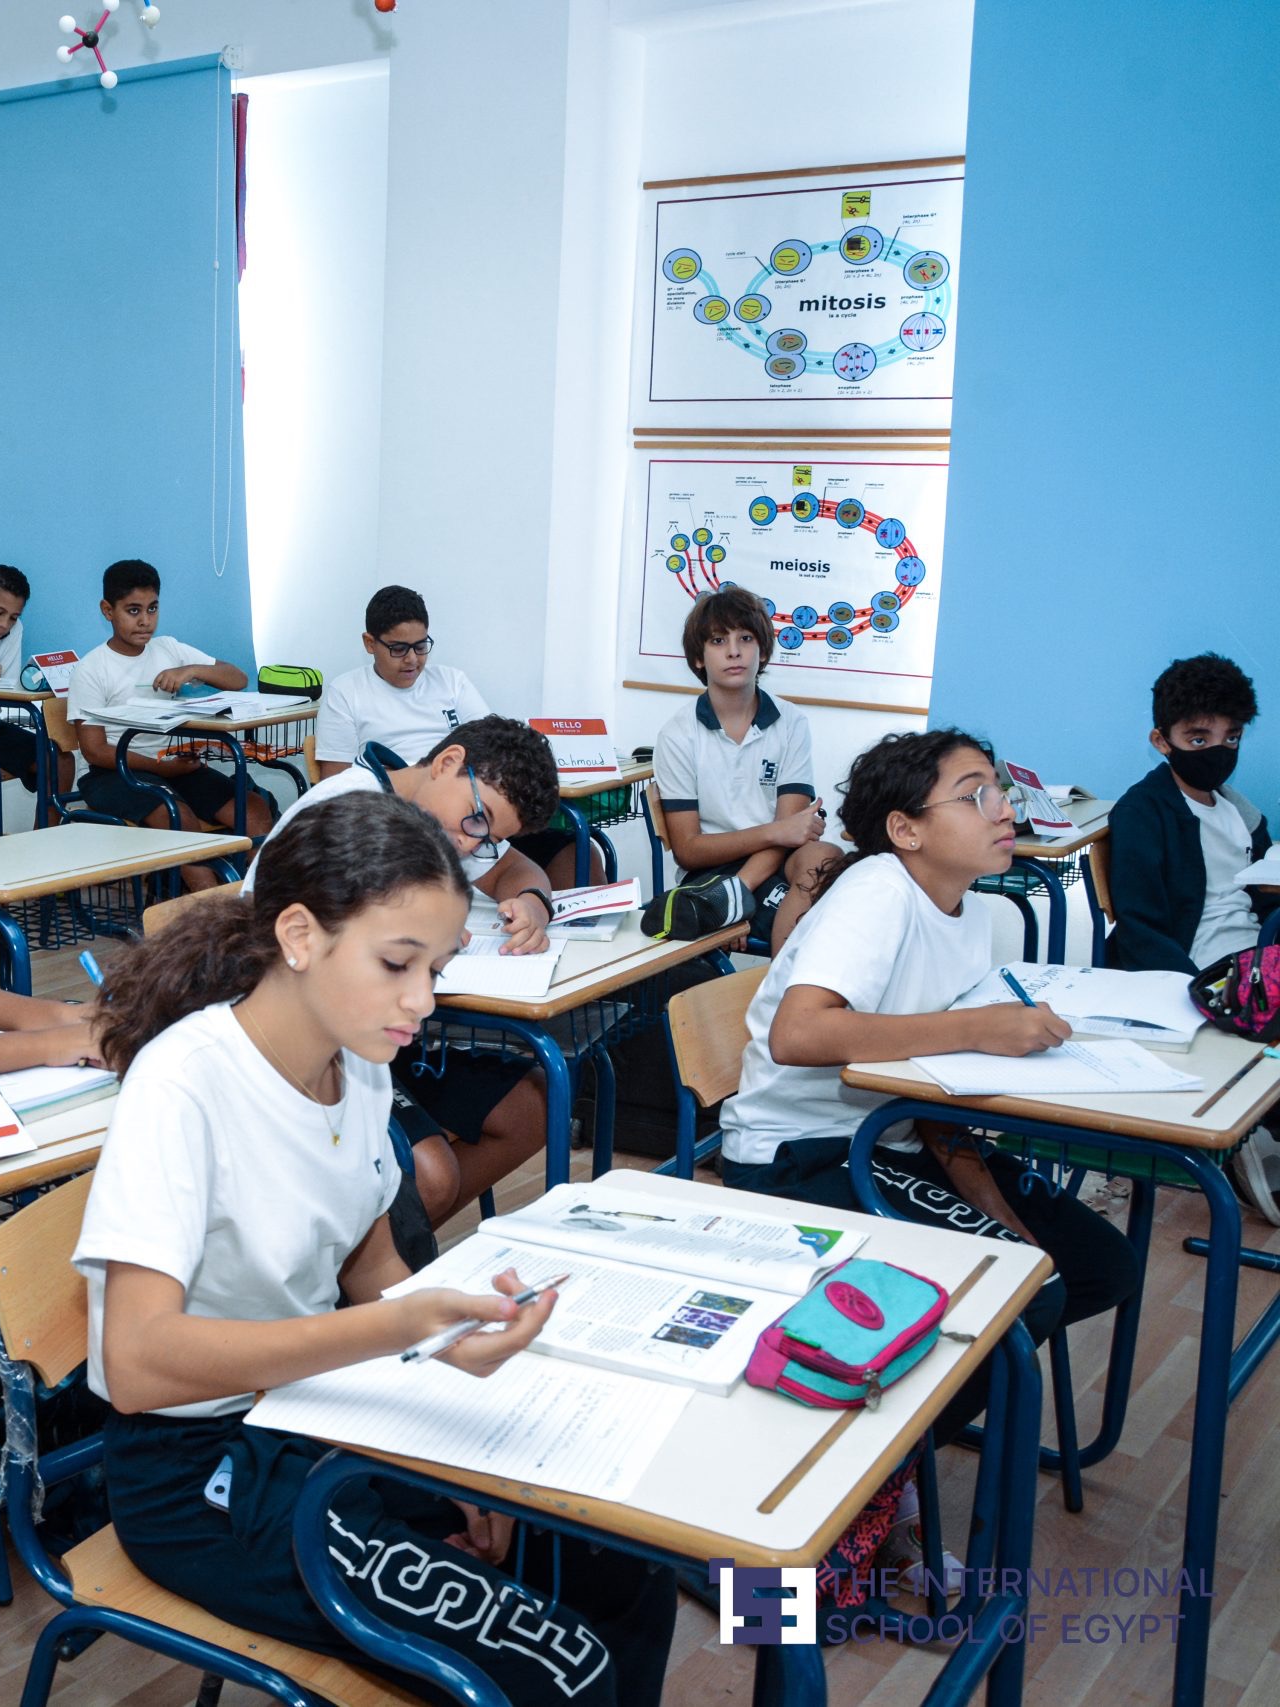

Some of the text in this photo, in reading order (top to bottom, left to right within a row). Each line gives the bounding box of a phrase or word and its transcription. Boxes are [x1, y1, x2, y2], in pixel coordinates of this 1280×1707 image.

[799, 293, 886, 312] mitosis
[770, 559, 831, 573] meiosis
[557, 752, 605, 767] ahmoud
[327, 1508, 610, 1698] ISE
